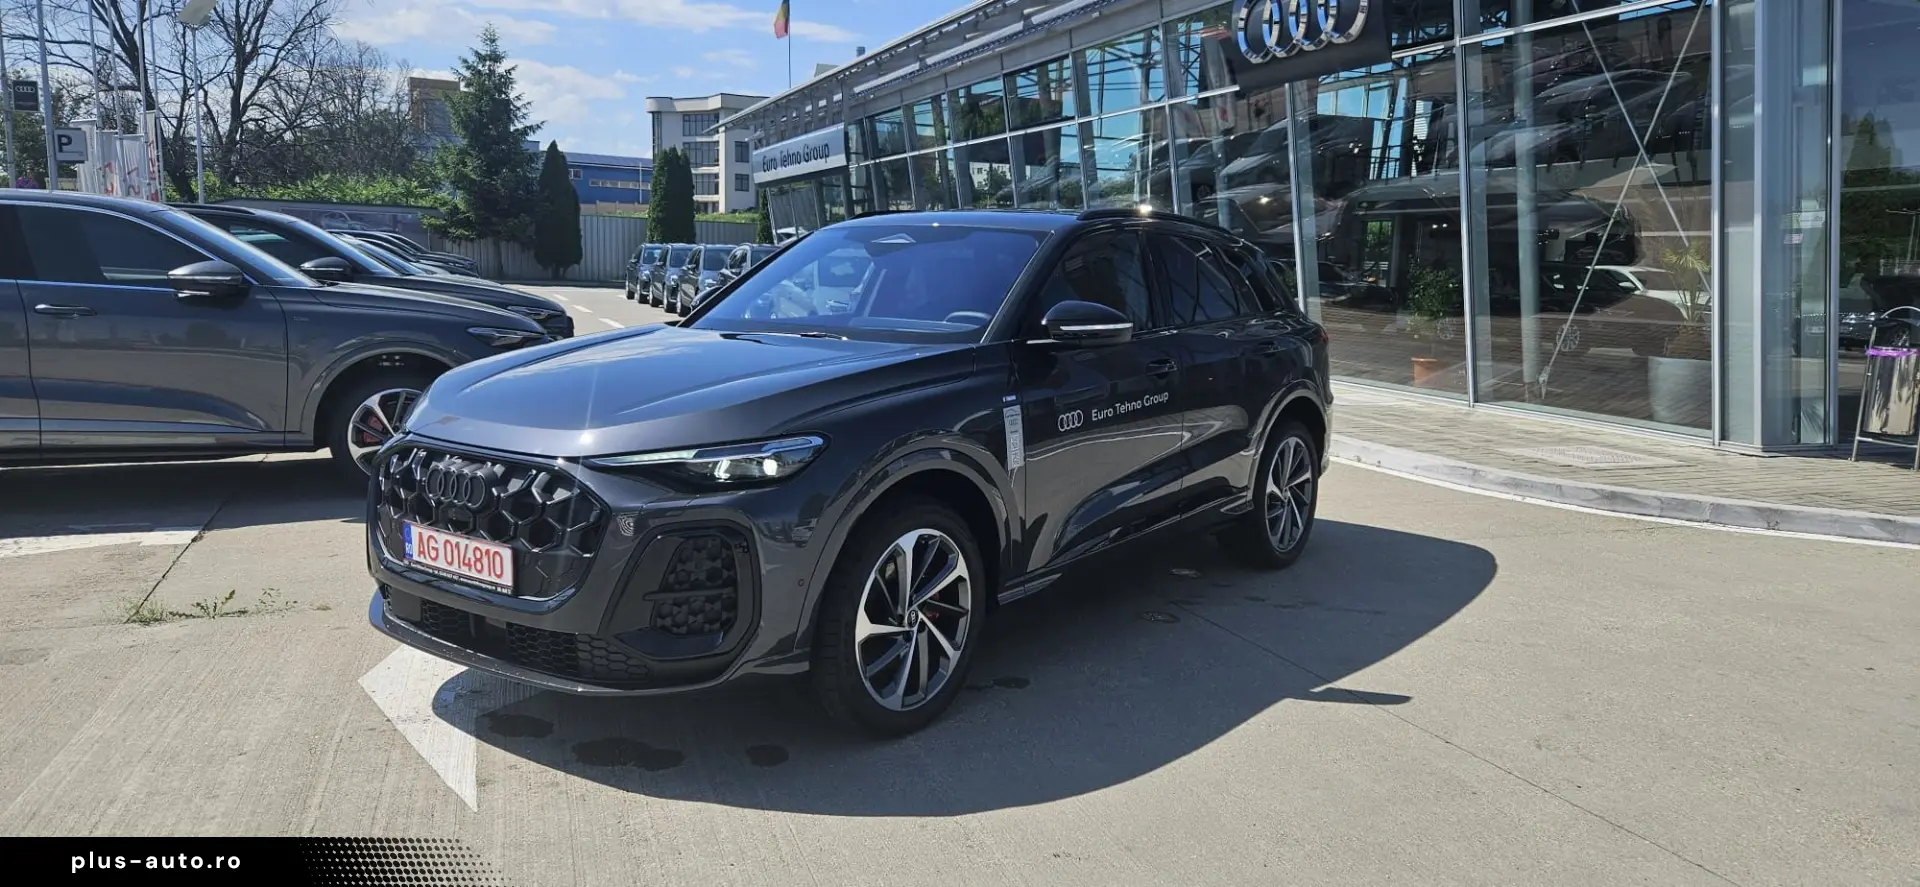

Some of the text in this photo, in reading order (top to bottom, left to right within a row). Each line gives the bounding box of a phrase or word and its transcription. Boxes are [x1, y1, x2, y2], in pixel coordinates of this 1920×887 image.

[57, 134, 73, 153] P
[762, 142, 830, 173] Euro Tehno Group
[1091, 392, 1169, 421] Euro Tehno Group
[405, 542, 413, 555] RO
[417, 531, 504, 579] AG 014810
